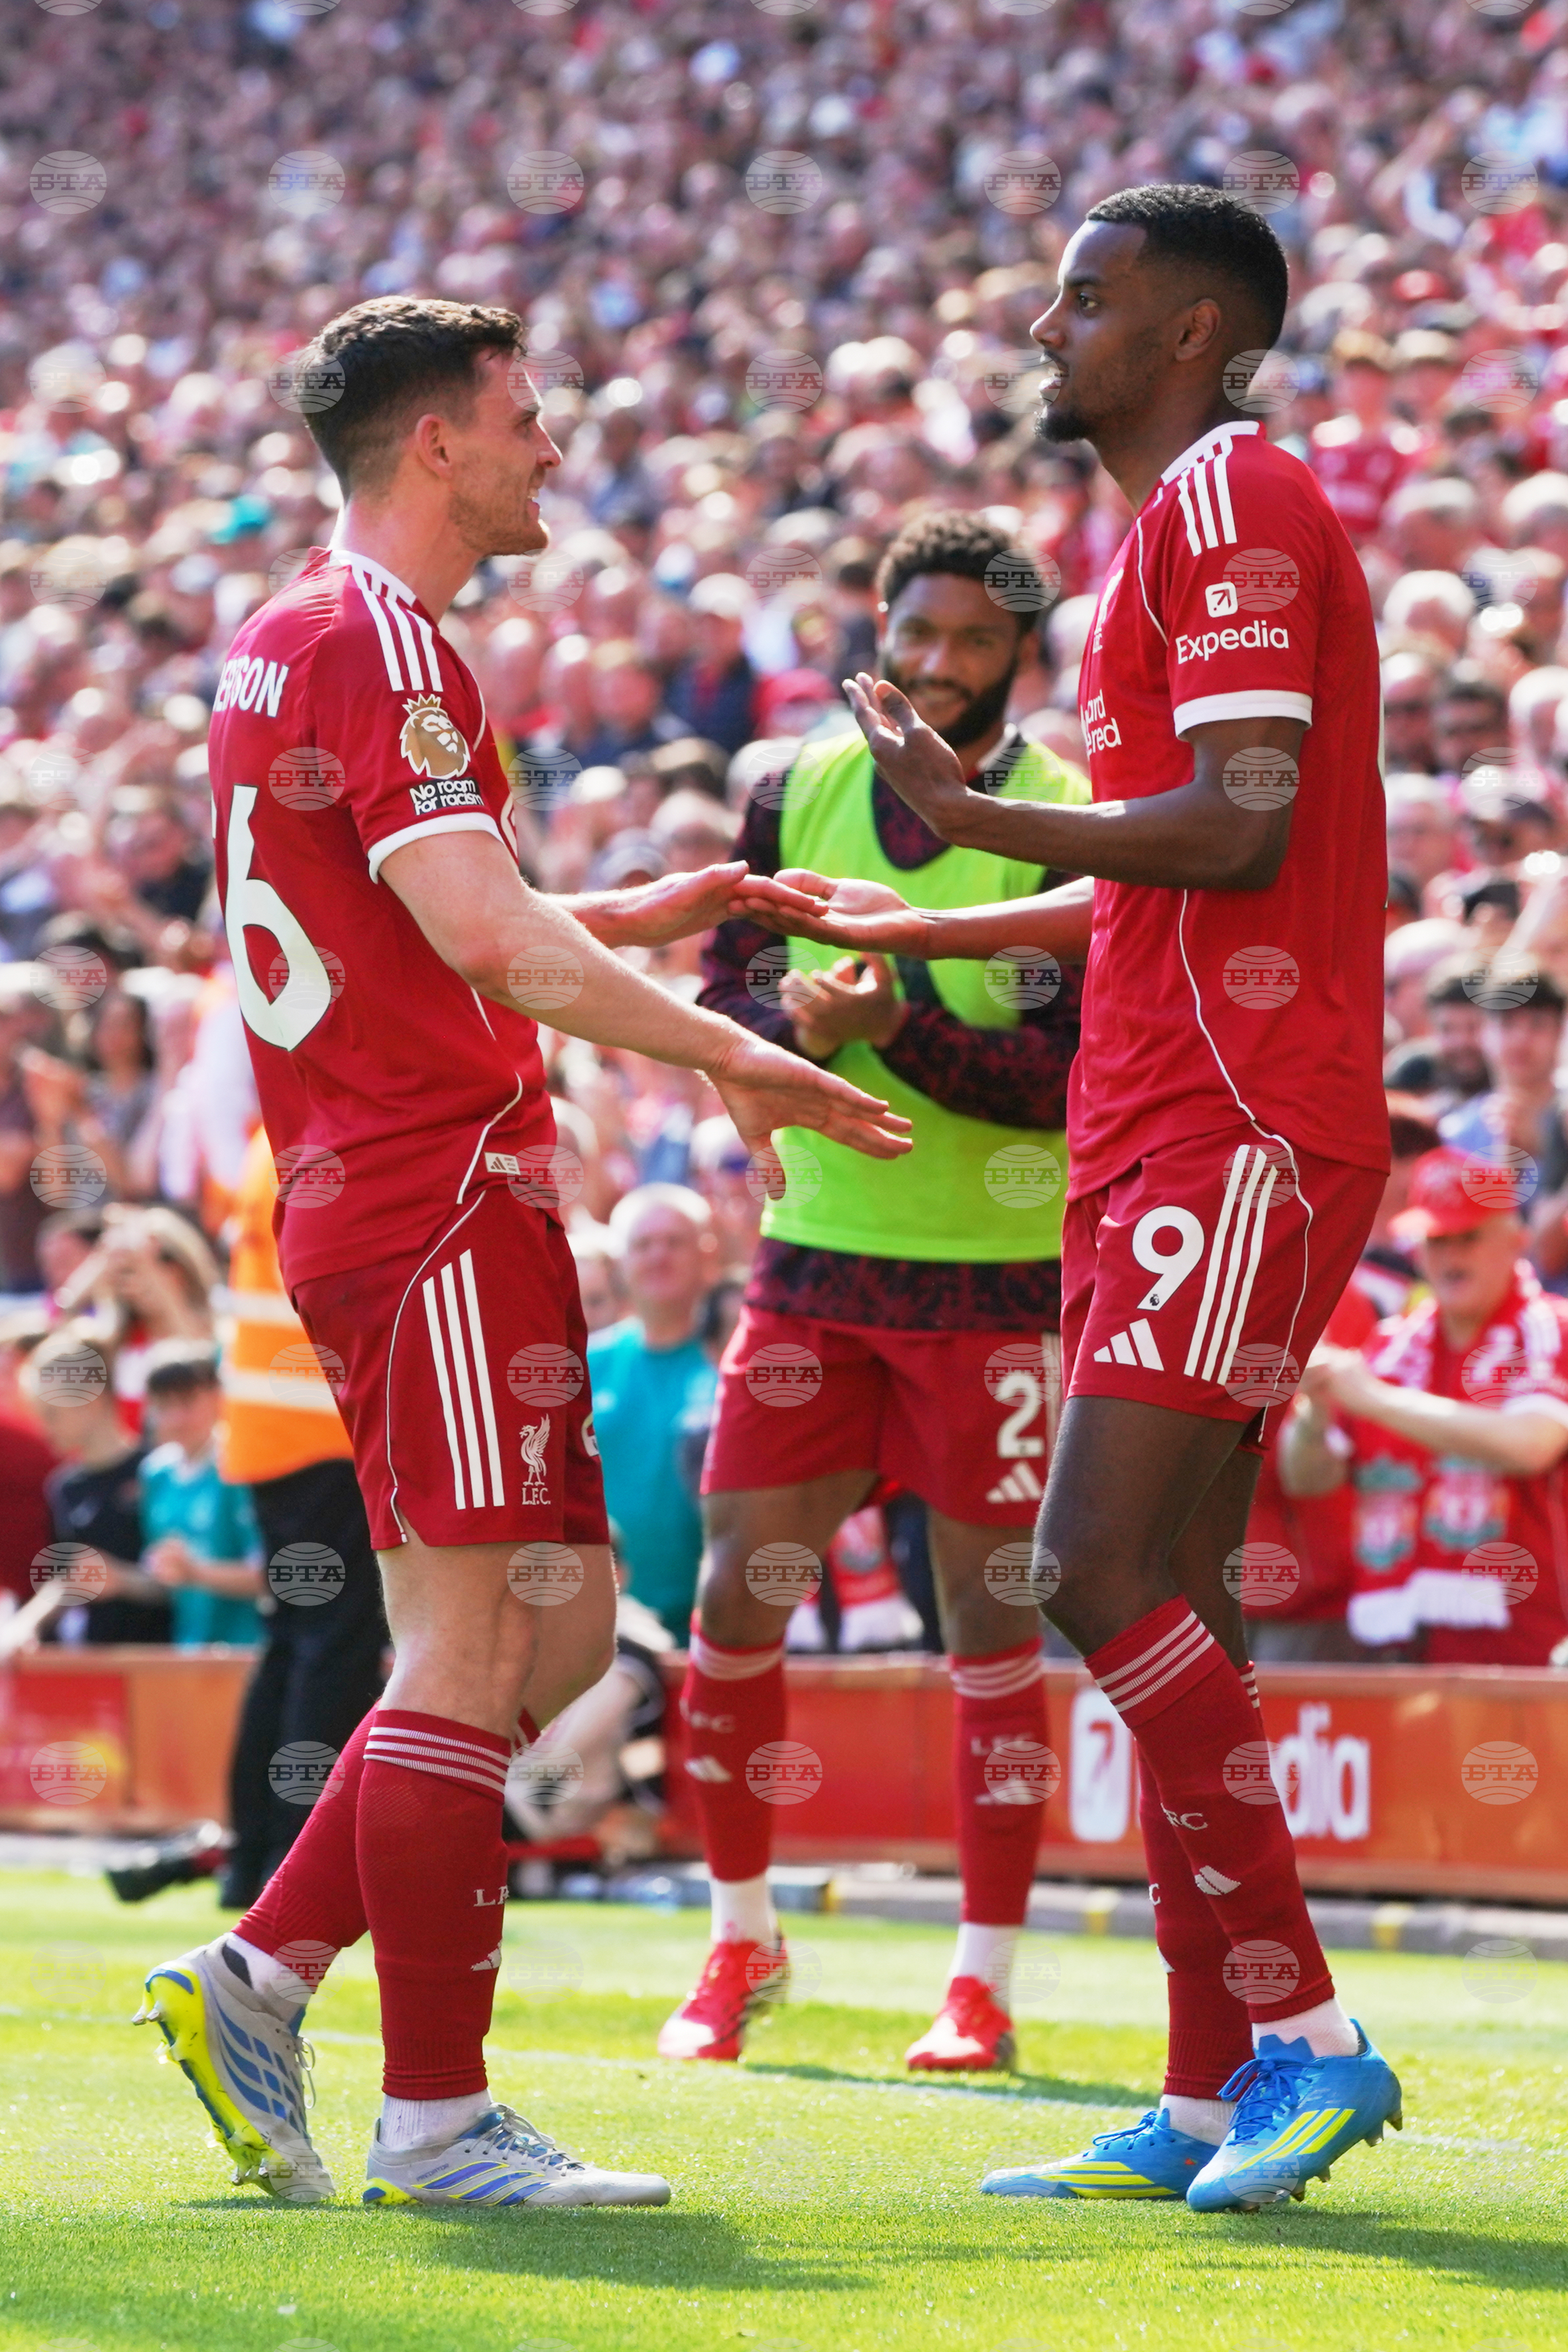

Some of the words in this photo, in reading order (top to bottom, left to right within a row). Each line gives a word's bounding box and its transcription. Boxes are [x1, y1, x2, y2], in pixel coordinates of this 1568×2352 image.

[1175, 620, 1290, 665] Expedia
[410, 784, 436, 803] No
[437, 779, 476, 795] room
[414, 796, 438, 816] for
[439, 793, 484, 807] racism
[211, 784, 332, 1053] 6
[1132, 1205, 1205, 1311] 9
[997, 1373, 1045, 1458] 2
